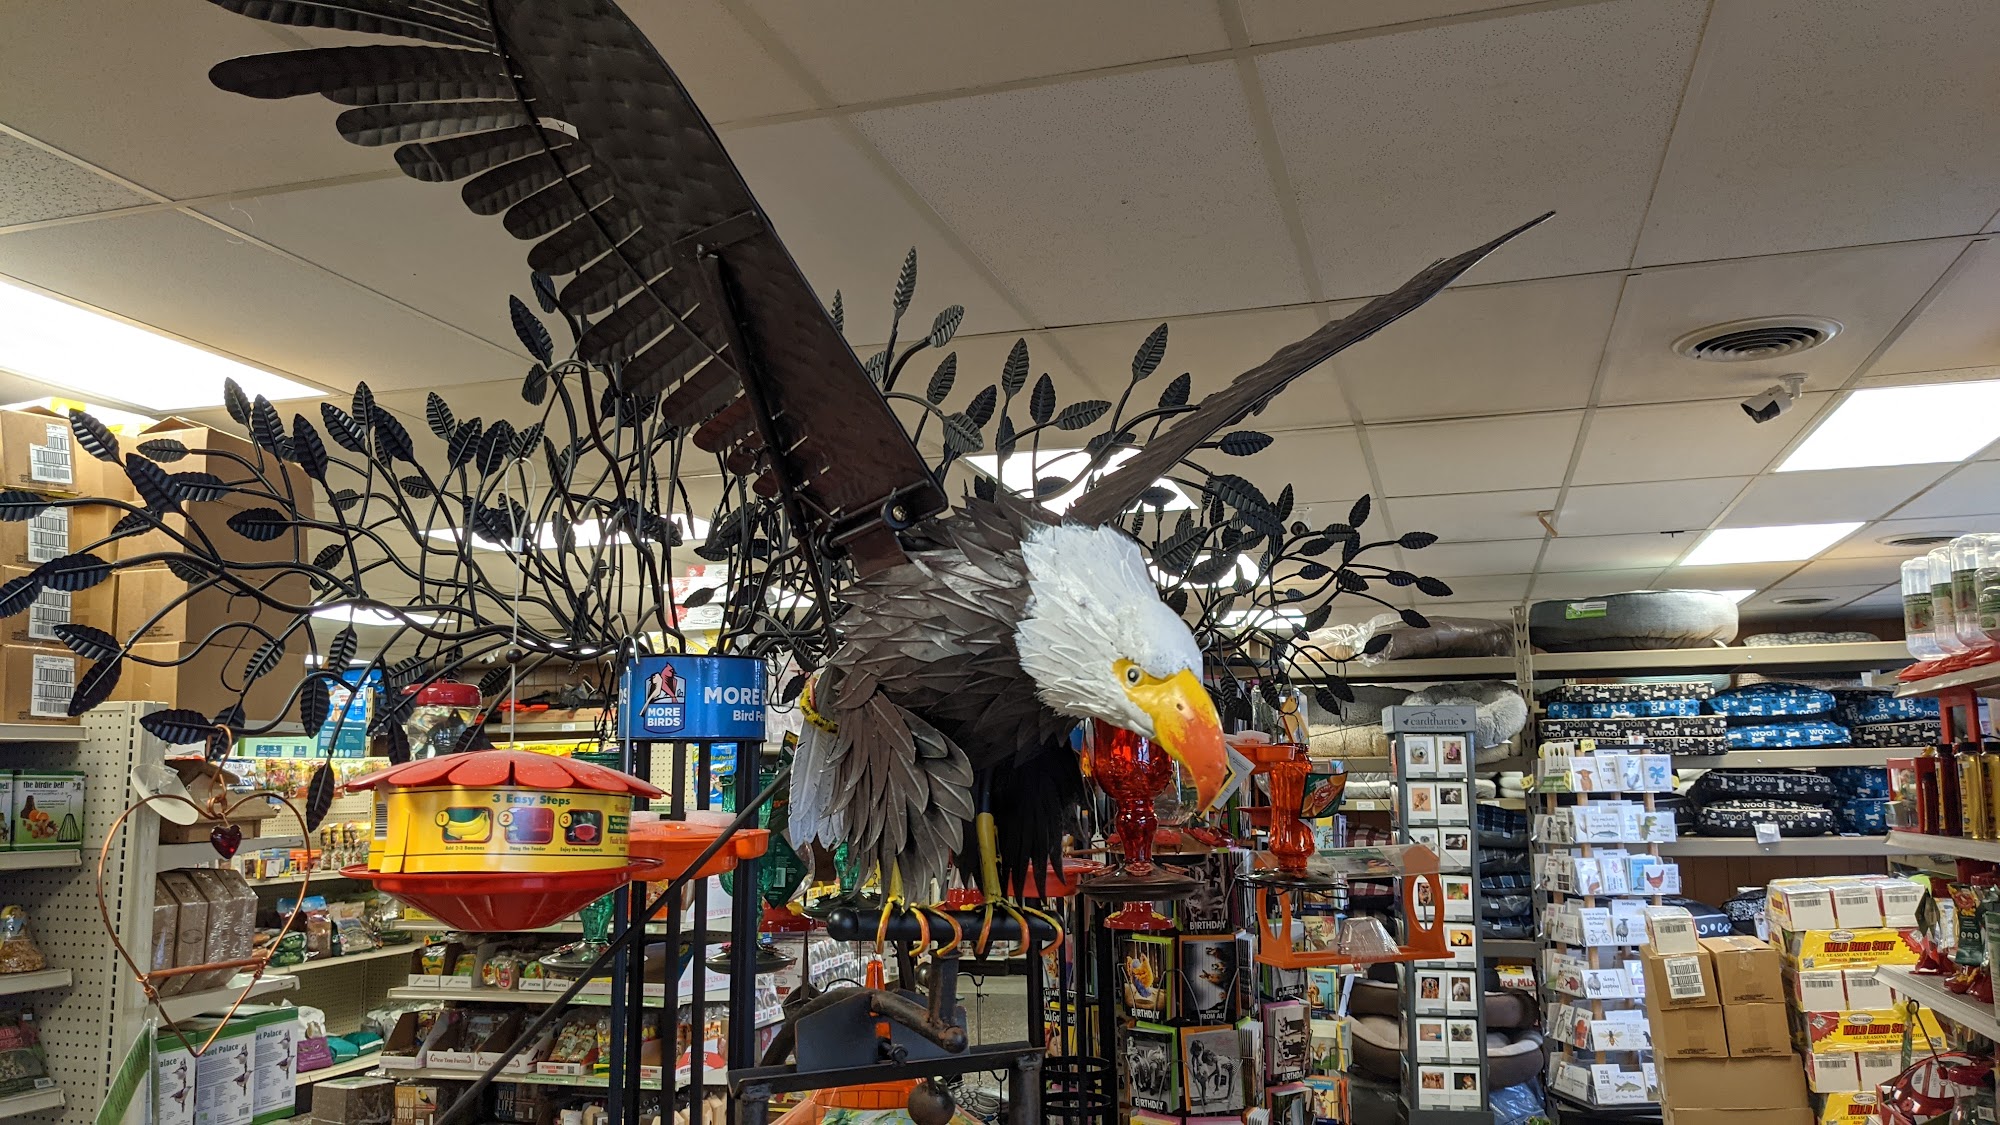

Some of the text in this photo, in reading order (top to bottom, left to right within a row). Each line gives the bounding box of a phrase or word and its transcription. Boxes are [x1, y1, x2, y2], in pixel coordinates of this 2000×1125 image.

[704, 687, 760, 706] MORE
[648, 708, 681, 717] MORE
[733, 709, 755, 722] Bird
[647, 717, 681, 727] BIRDS
[1411, 716, 1459, 726] cardthartic
[1596, 729, 1622, 738] woof
[1654, 728, 1680, 737] woof
[1750, 730, 1777, 738] woof
[23, 781, 65, 789] the birdie bell
[493, 794, 571, 807] 3 Easy Steps
[440, 813, 445, 823] 1
[503, 813, 510, 823] 2
[563, 815, 569, 825] 3
[1722, 812, 1804, 821] woof woof
[1189, 920, 1227, 930] BIRTHDAY
[1824, 940, 1896, 952] WILD BIRD SUET
[1517, 977, 1536, 987] Mix
[1131, 1008, 1160, 1019] BRTHDAY
[1200, 1012, 1216, 1020] FROM
[263, 1029, 282, 1039] Palace
[1843, 1025, 1867, 1036] WILD
[1868, 1024, 1891, 1035] BIRD
[218, 1043, 239, 1055] Palace
[159, 1058, 178, 1068] alace
[1134, 1098, 1164, 1110] BRTHDAY
[397, 1108, 414, 1119] BIRD
[1848, 1104, 1872, 1116] WILD
